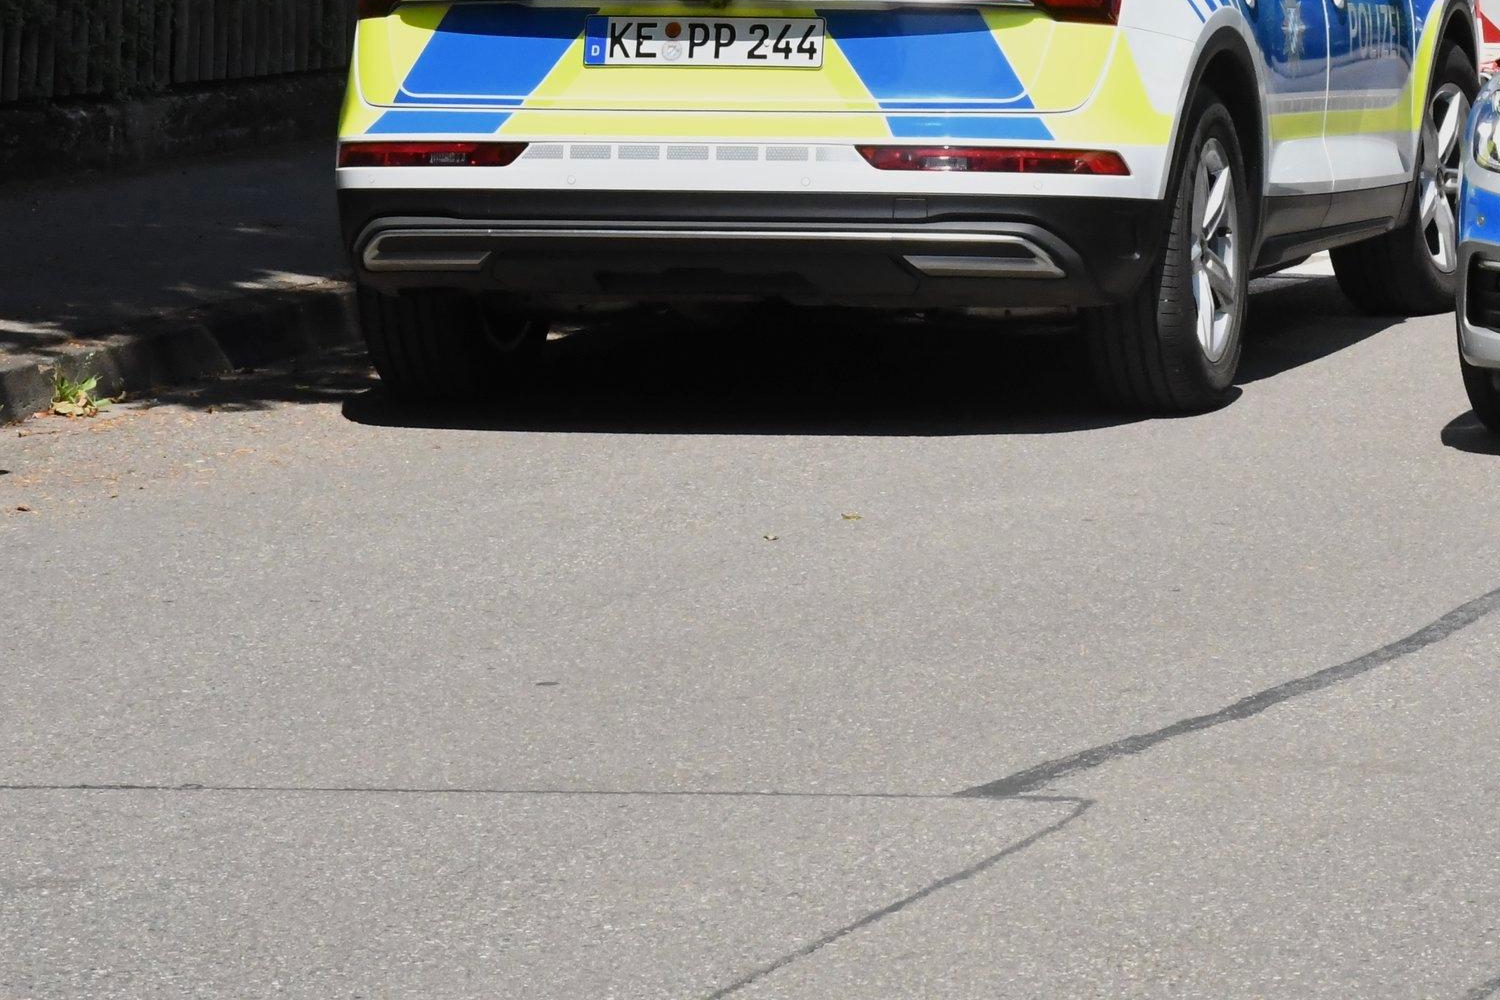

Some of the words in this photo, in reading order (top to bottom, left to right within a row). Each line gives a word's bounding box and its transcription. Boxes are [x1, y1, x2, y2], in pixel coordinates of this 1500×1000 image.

[609, 22, 658, 58] KE
[688, 23, 736, 58] PP
[747, 24, 817, 60] 244
[1347, 2, 1401, 59] POLIZEI
[591, 45, 600, 56] D
